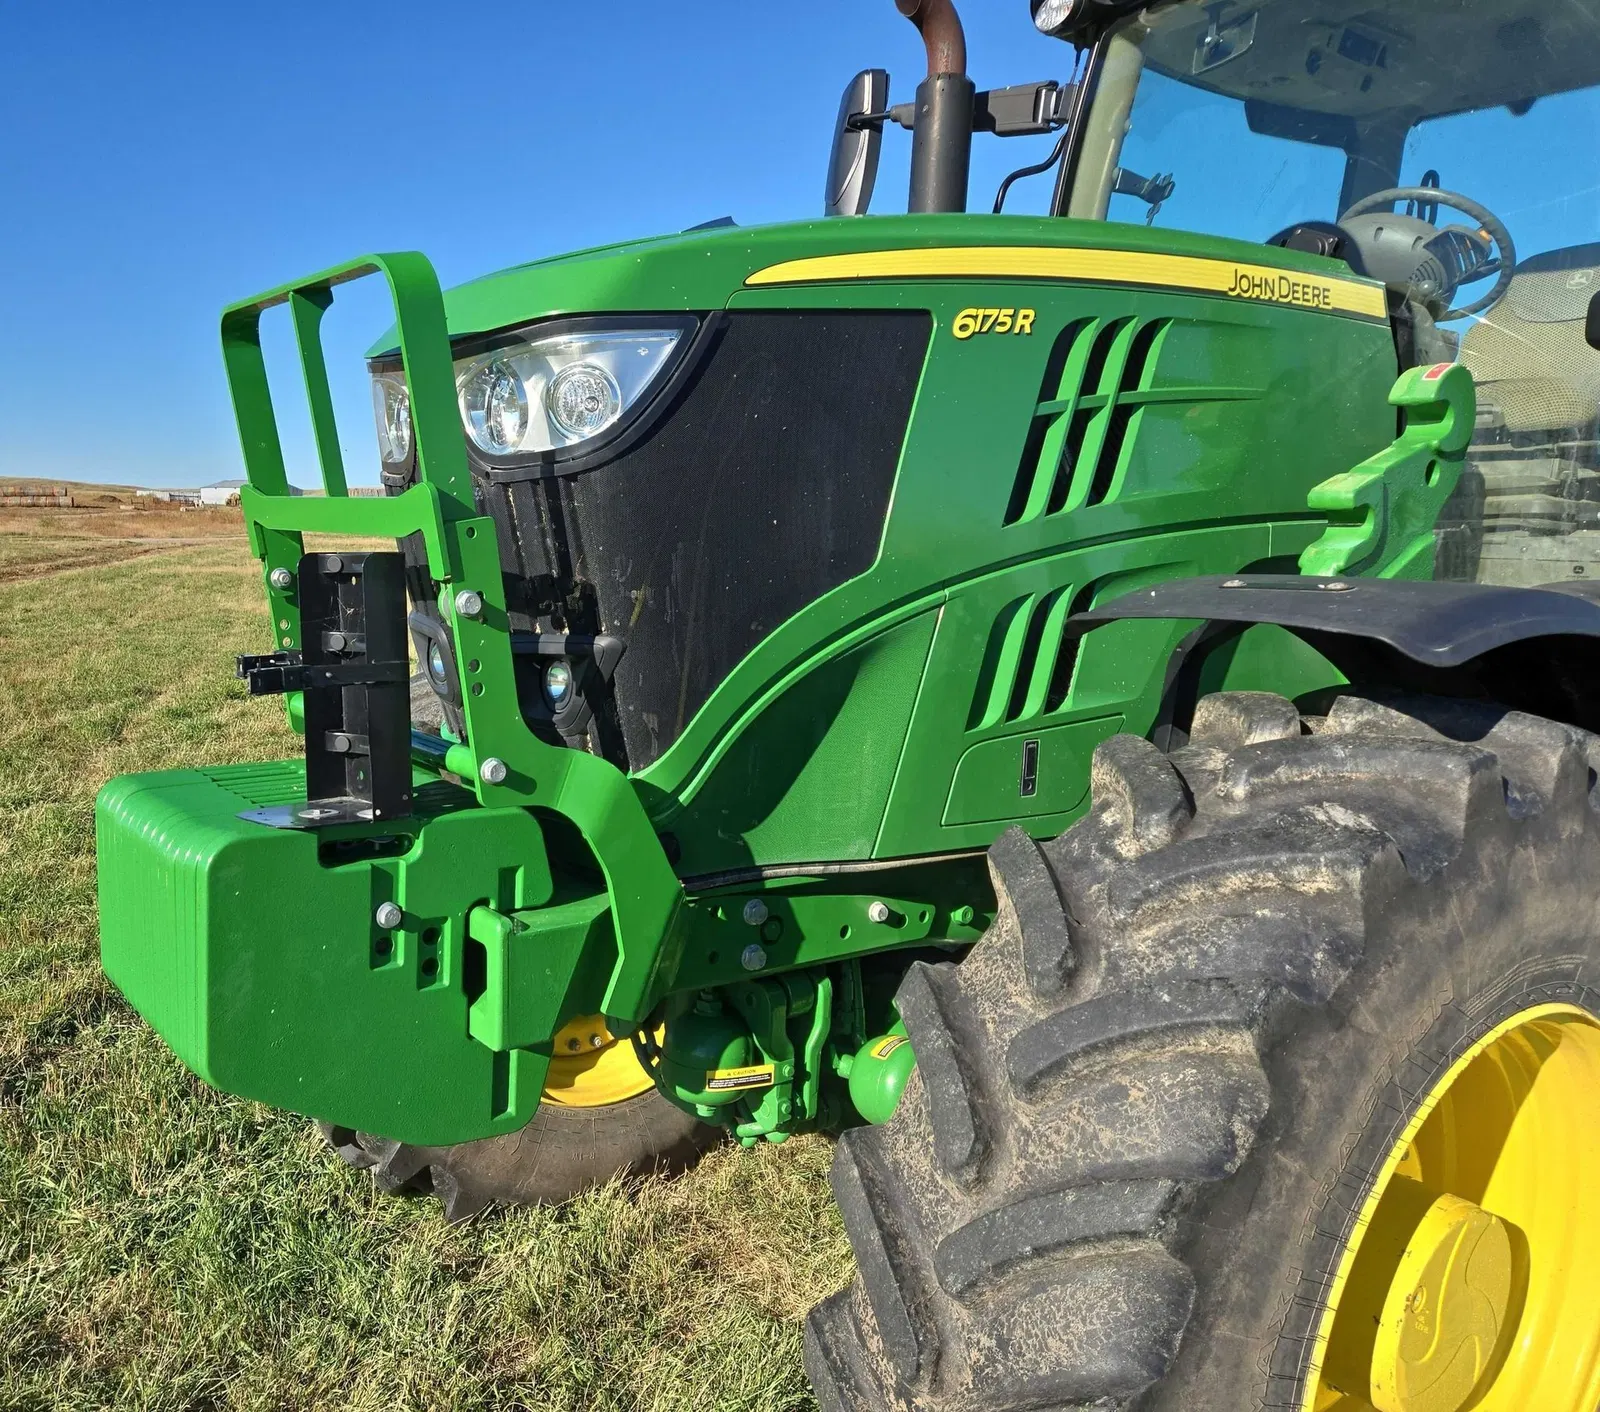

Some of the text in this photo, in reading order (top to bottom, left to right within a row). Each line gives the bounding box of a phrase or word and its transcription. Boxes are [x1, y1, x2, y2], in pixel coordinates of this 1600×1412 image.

[1227, 268, 1333, 307] JOHN DEERE
[952, 307, 1036, 341] 6175R
[1299, 978, 1454, 1247] TRACTION
